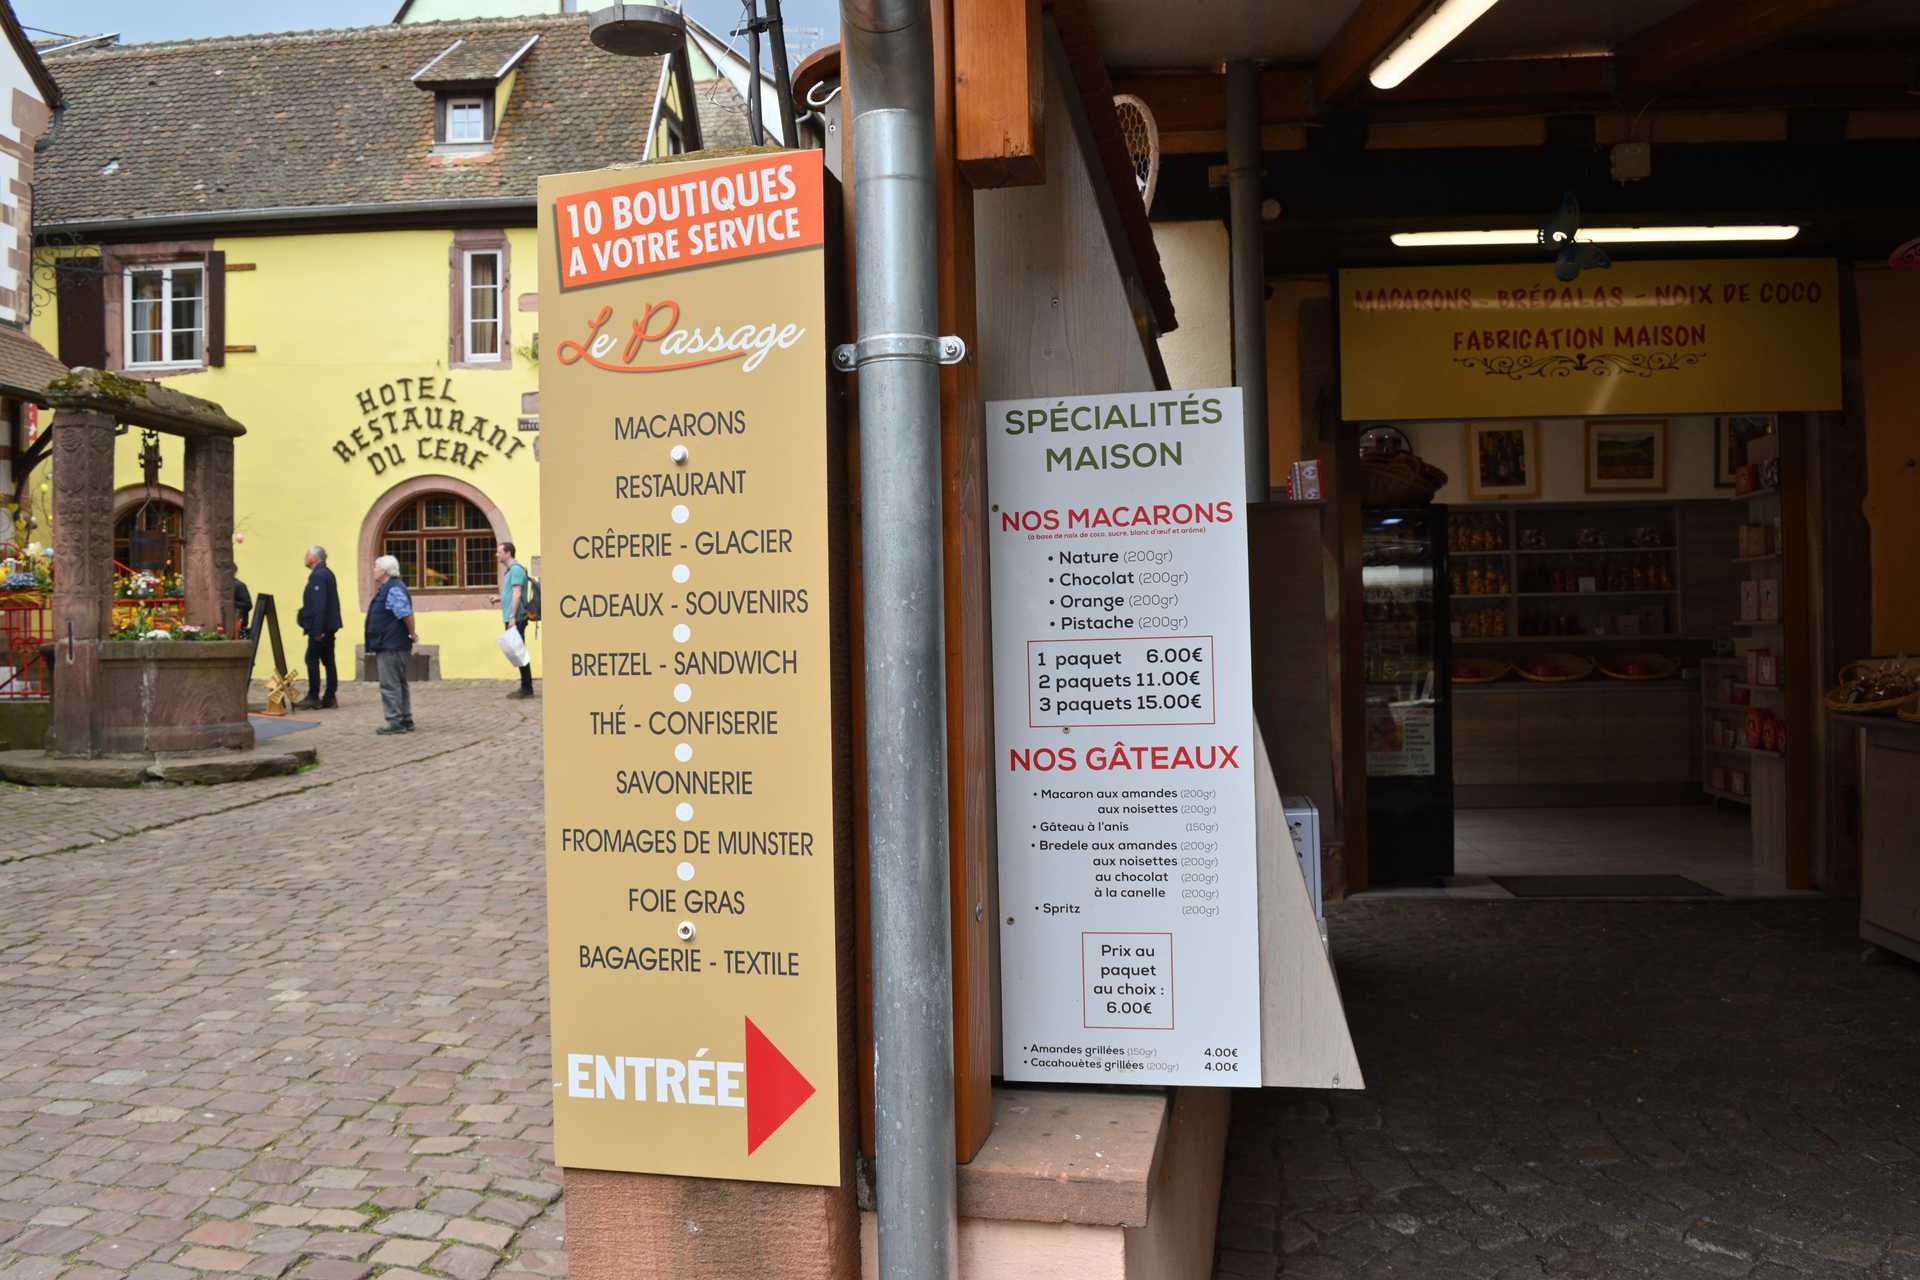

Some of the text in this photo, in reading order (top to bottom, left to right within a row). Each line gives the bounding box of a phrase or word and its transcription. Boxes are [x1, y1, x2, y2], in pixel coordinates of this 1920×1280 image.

[567, 164, 797, 238] 10 BOUTIQUES
[569, 207, 800, 277] A VOTRE SERVICE
[1354, 288, 1472, 313] MACARONS
[1656, 283, 1713, 307] NOIX
[1723, 282, 1750, 304] DE
[1760, 281, 1822, 304] COCO
[558, 300, 805, 373] Le Passage
[1454, 324, 1705, 350] FABRICATION MAISON
[356, 376, 456, 416] HOTEL
[615, 410, 746, 440] MACARONS
[1005, 393, 1223, 436] SPÉCIALITÉS
[332, 406, 525, 463] RESTAURANT
[367, 437, 489, 476] DU CERF
[1046, 441, 1182, 473] MAISON
[616, 470, 746, 499] RESTAURANT
[1002, 501, 1233, 532] NOS MACARONS
[573, 528, 672, 559] CRÊPERIE
[695, 529, 793, 555] GLACIER
[1130, 528, 1149, 536] blanc
[1059, 550, 1173, 566] Nature (200gr)
[1060, 571, 1188, 587] Chocolat (200gr)
[560, 592, 664, 618] CADEAUX
[686, 589, 808, 616] SOUVENIRS
[1060, 594, 1178, 611] Orange (200gr)
[1061, 616, 1188, 632] Pistache (200gr)
[572, 652, 651, 677] BRETZEL
[674, 650, 797, 676] SANDWICH
[1038, 648, 1203, 670] 1 paquet 6.00€
[1038, 671, 1200, 692] 2 paquets 11.00€
[1040, 694, 1202, 715] 3 paquets 15.00€
[590, 704, 626, 736] THÉ
[649, 710, 778, 735] CONFISERIE
[1010, 741, 1239, 771] NOS GÂTEAUX
[616, 770, 753, 795] SAVONNERIE
[1041, 788, 1216, 800] Macaron aux amandes (200gr)
[1098, 804, 1217, 815] aux noisettes (200gr)
[1040, 821, 1219, 834] Gâteau à l'anis (150gr)
[562, 828, 813, 856] FROMAGES DE MUNSTER
[1039, 840, 1218, 852] Bredele aux amandes (200gr)
[1092, 856, 1219, 868] aux noisettes (200gr)
[1096, 872, 1219, 884] au chocolat (200gr)
[629, 888, 745, 915] FOIE GRAS
[1094, 887, 1220, 900] à la canelle (200gr)
[1043, 903, 1220, 917] Spritz (200gr)
[580, 945, 701, 972] BAGAGERIE
[724, 950, 799, 977] TEXTILE
[1101, 944, 1155, 957] Prix au
[1101, 965, 1156, 979] paquet
[1094, 986, 1112, 995] au
[1117, 984, 1156, 995] choix
[1106, 1002, 1152, 1014] 6.00€
[1030, 1044, 1238, 1058] Amandes grillées (150gr) 4.00€
[568, 1048, 744, 1108] ENTRÉE
[1104, 1060, 1144, 1071] grillées
[1146, 1062, 1179, 1073] (200gr)
[1204, 1062, 1239, 1072] 4.00€
